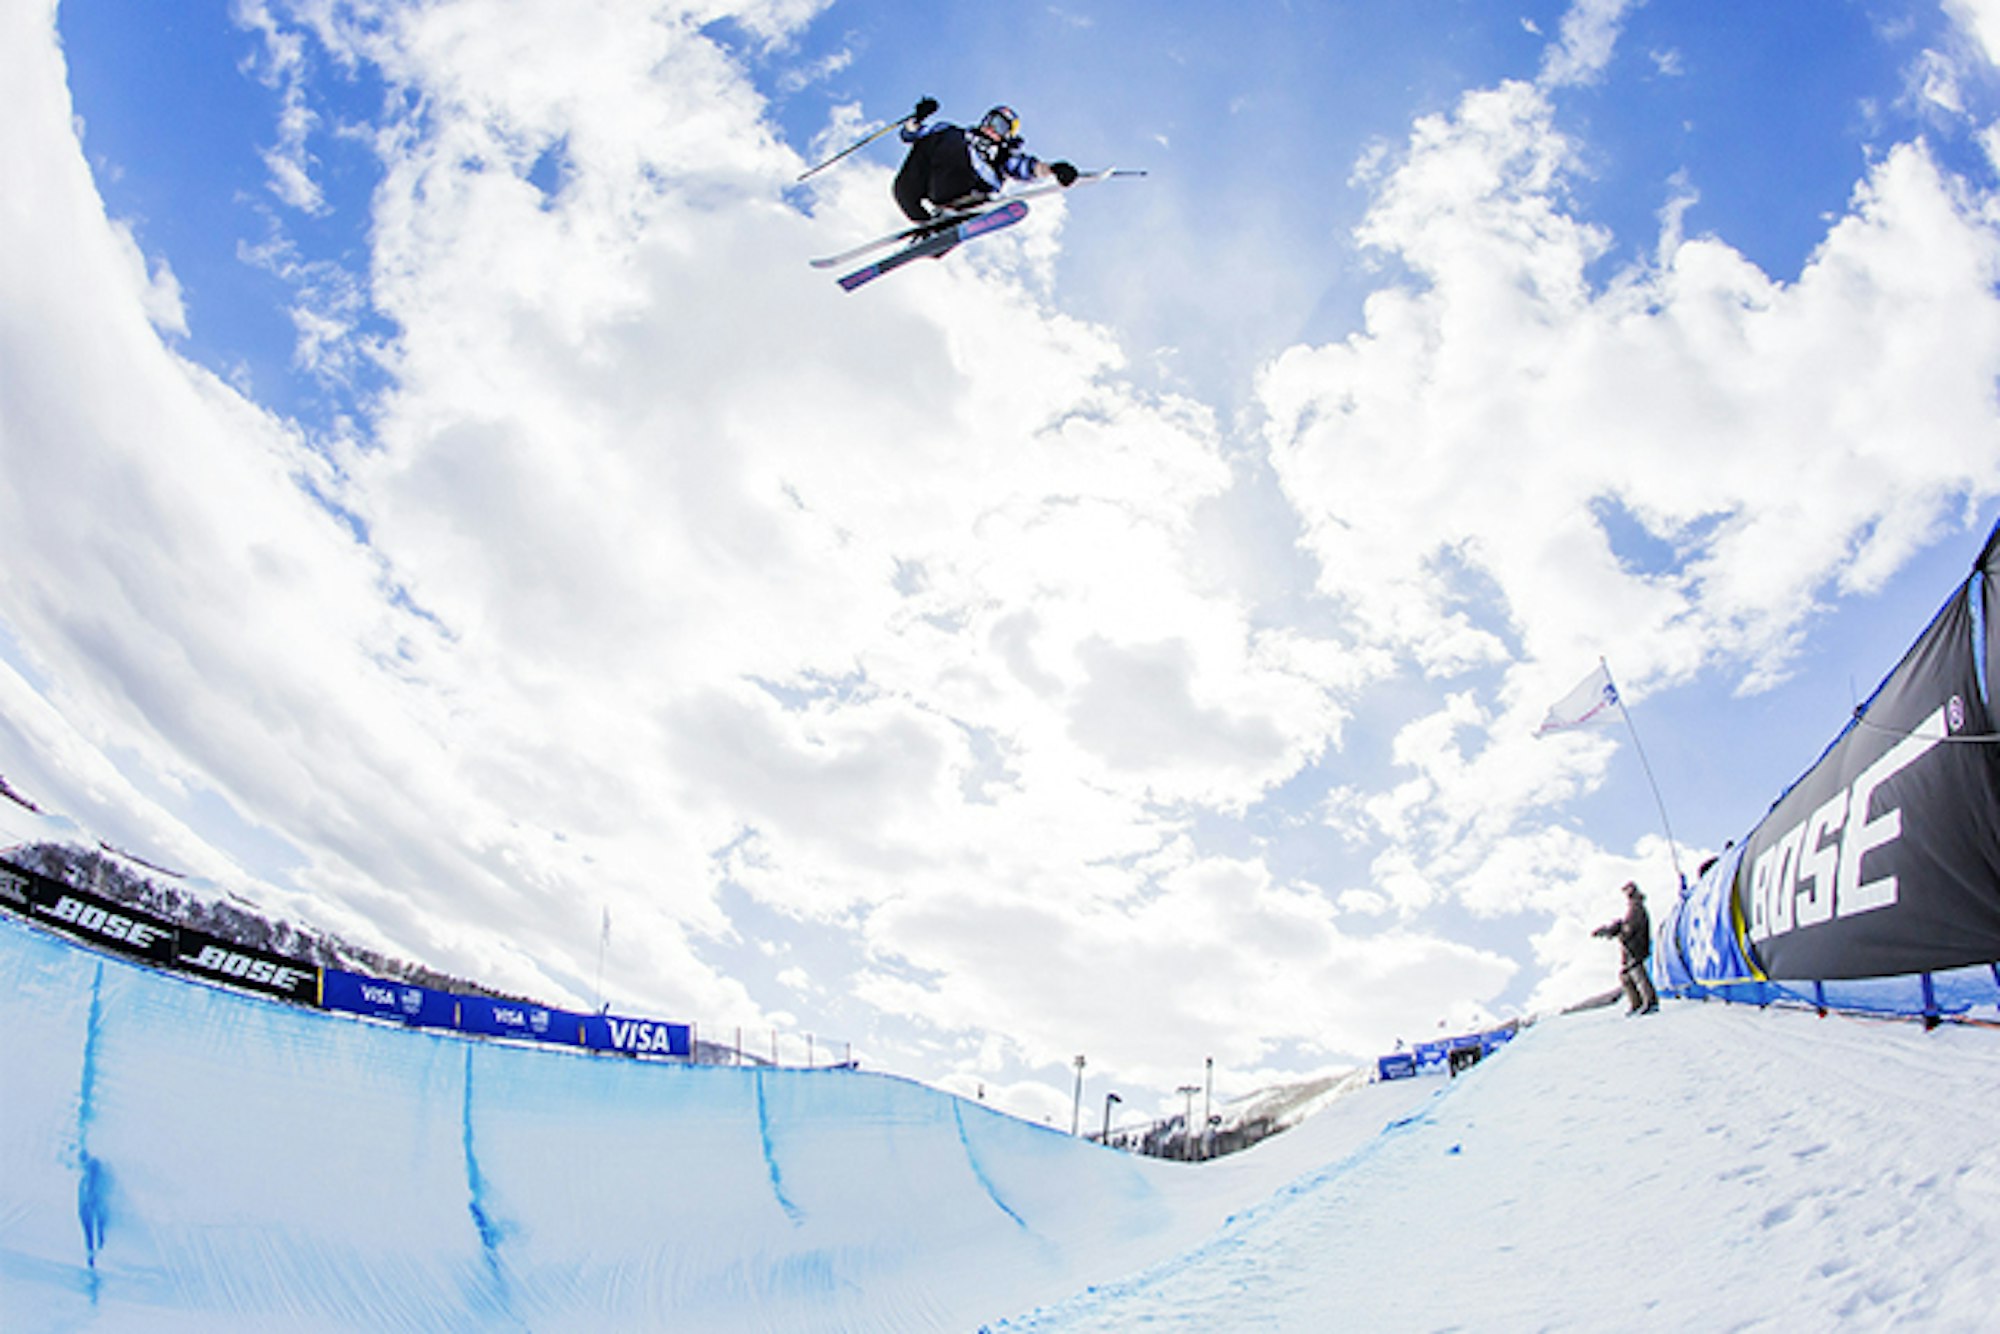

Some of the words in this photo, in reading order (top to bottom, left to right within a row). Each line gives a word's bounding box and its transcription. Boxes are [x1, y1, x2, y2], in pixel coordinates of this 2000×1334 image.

[1749, 704, 1948, 943] BOSE
[36, 896, 171, 947] BOSE
[178, 946, 314, 990] BOSE
[361, 984, 395, 1005] VISA
[492, 1007, 525, 1026] VISA
[607, 1021, 670, 1052] VISA
